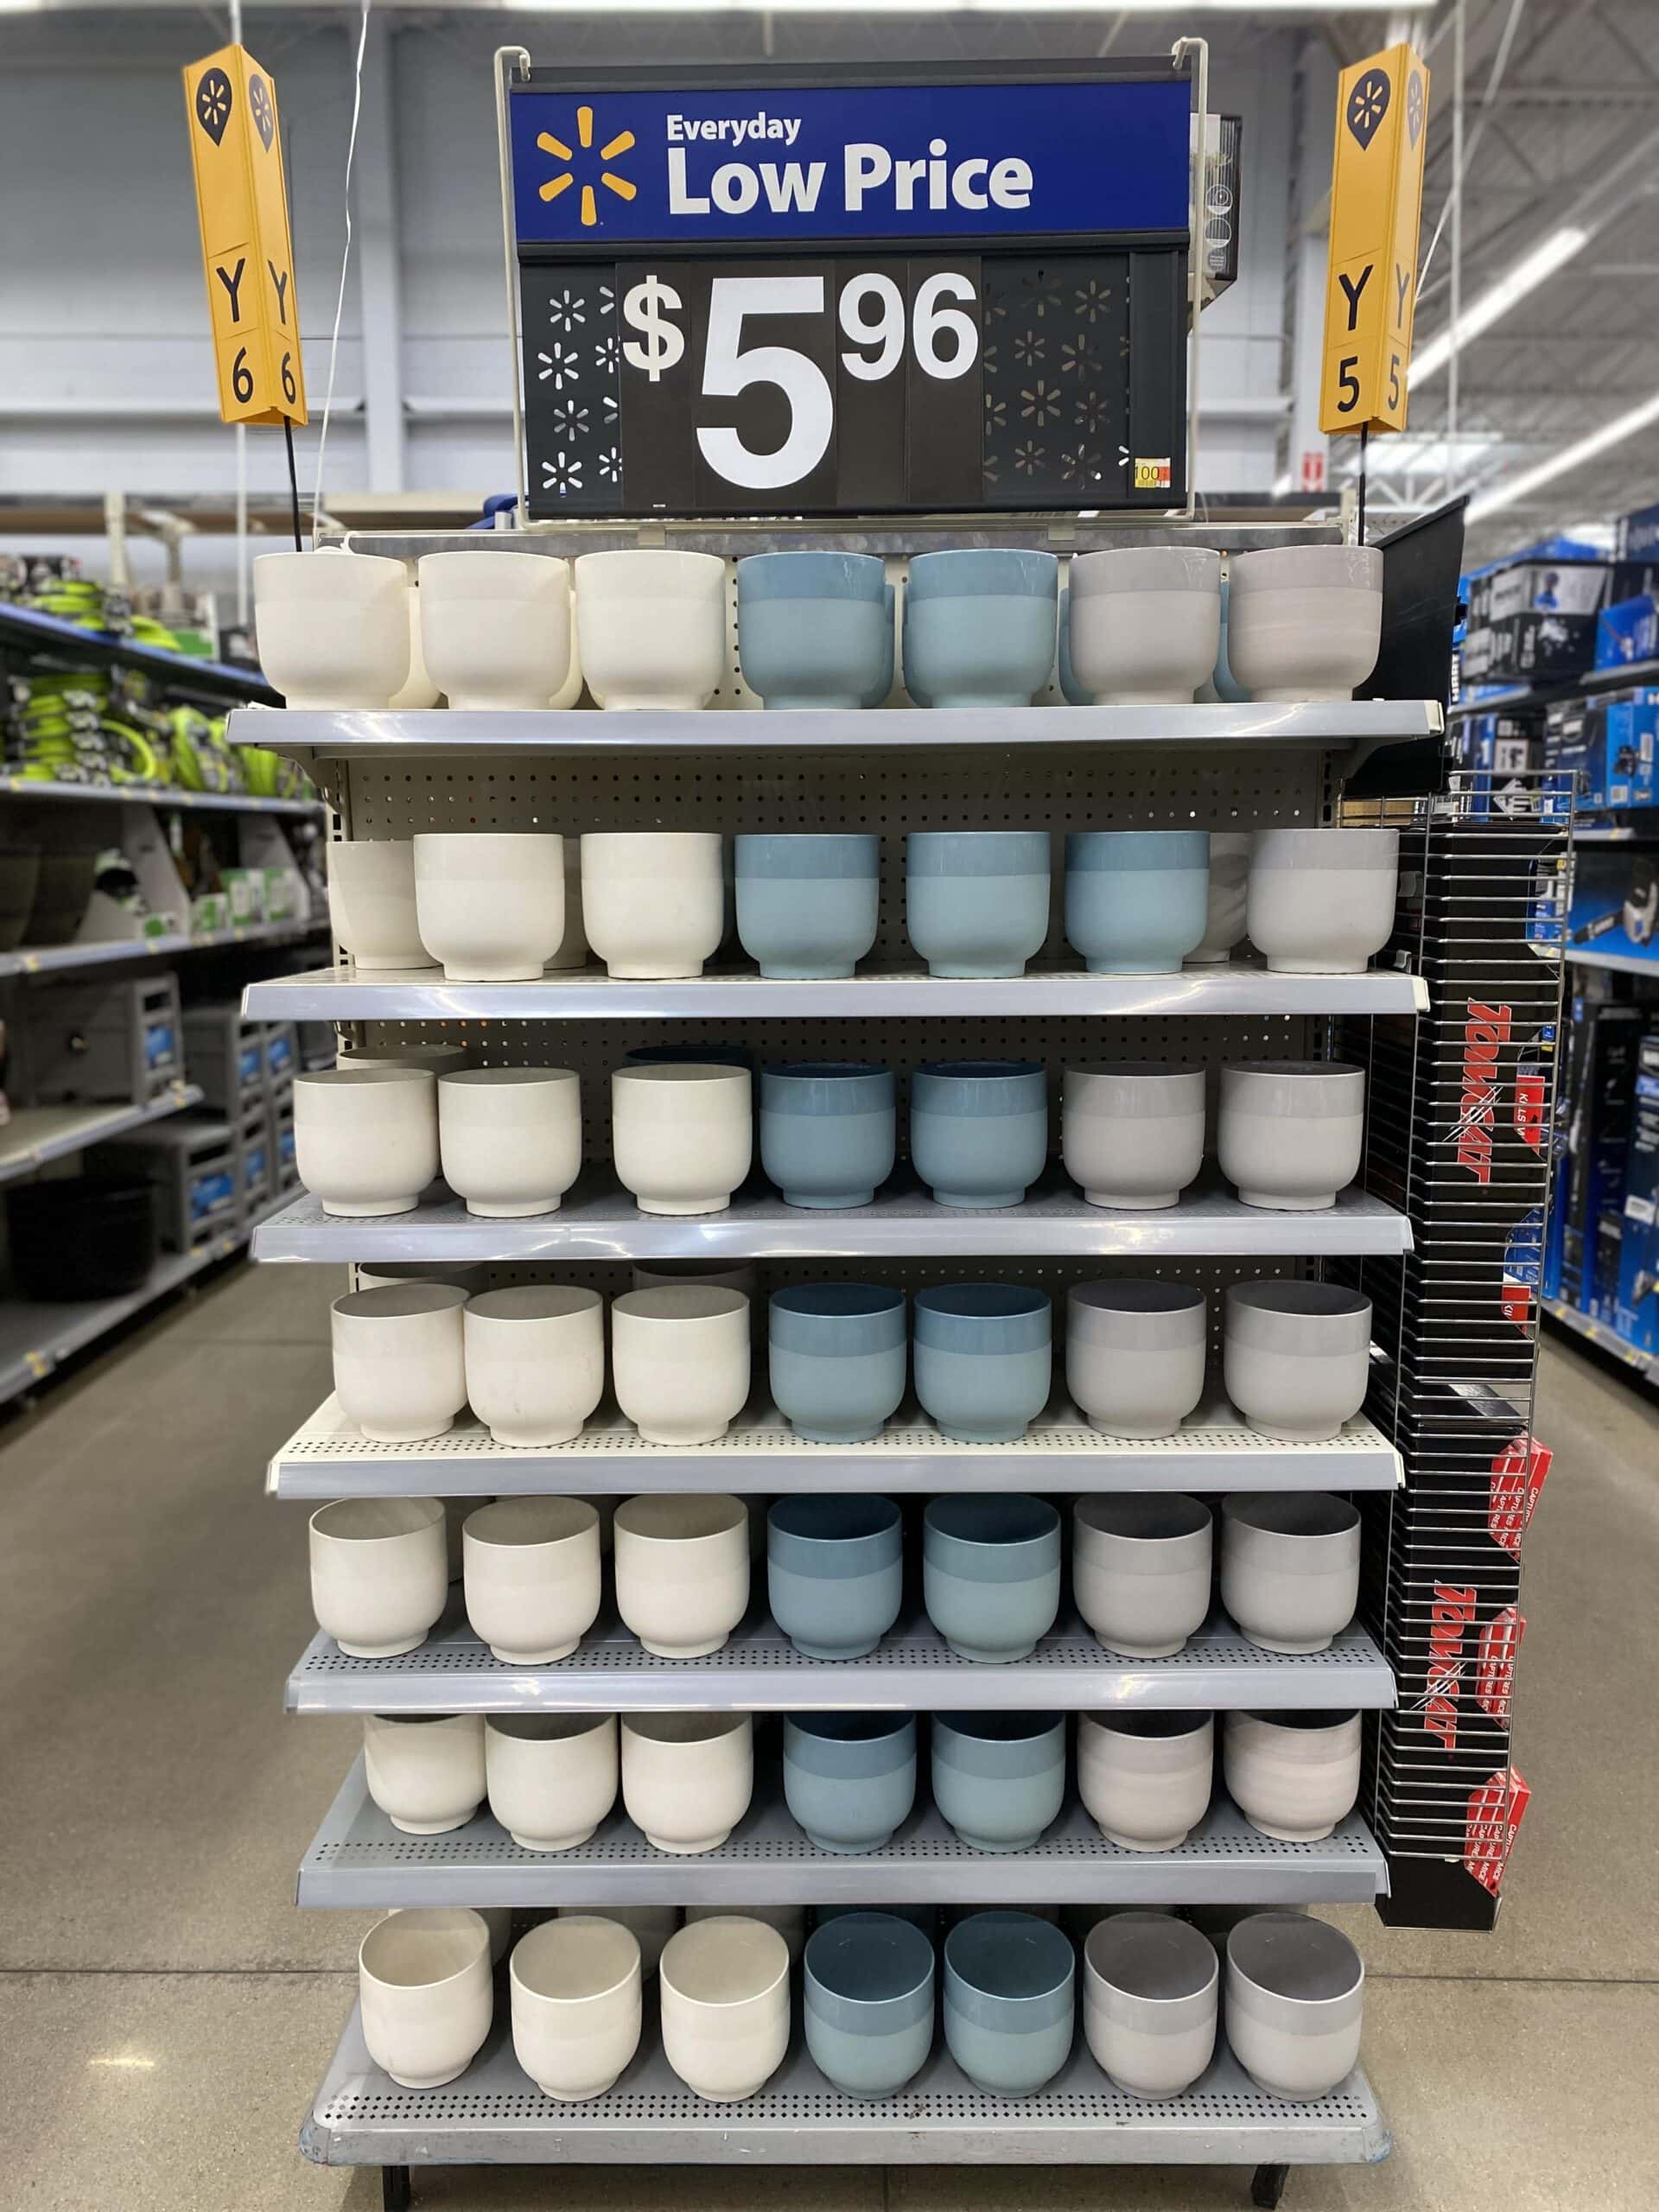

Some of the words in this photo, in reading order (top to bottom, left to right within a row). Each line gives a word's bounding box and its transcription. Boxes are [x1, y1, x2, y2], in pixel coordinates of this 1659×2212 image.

[666, 111, 802, 148] Everyday
[667, 146, 827, 215] Low
[843, 138, 1033, 212] Price
[216, 257, 245, 323] Y
[267, 258, 288, 326] Y
[1338, 264, 1374, 331] Y
[1395, 263, 1411, 329] Y
[232, 346, 253, 404] 6
[281, 352, 296, 404] 6
[1337, 355, 1360, 413] 5
[1388, 353, 1401, 410] 5
[1458, 996, 1512, 1184] TOMCAT
[1424, 1580, 1478, 1749] TOMCAT
